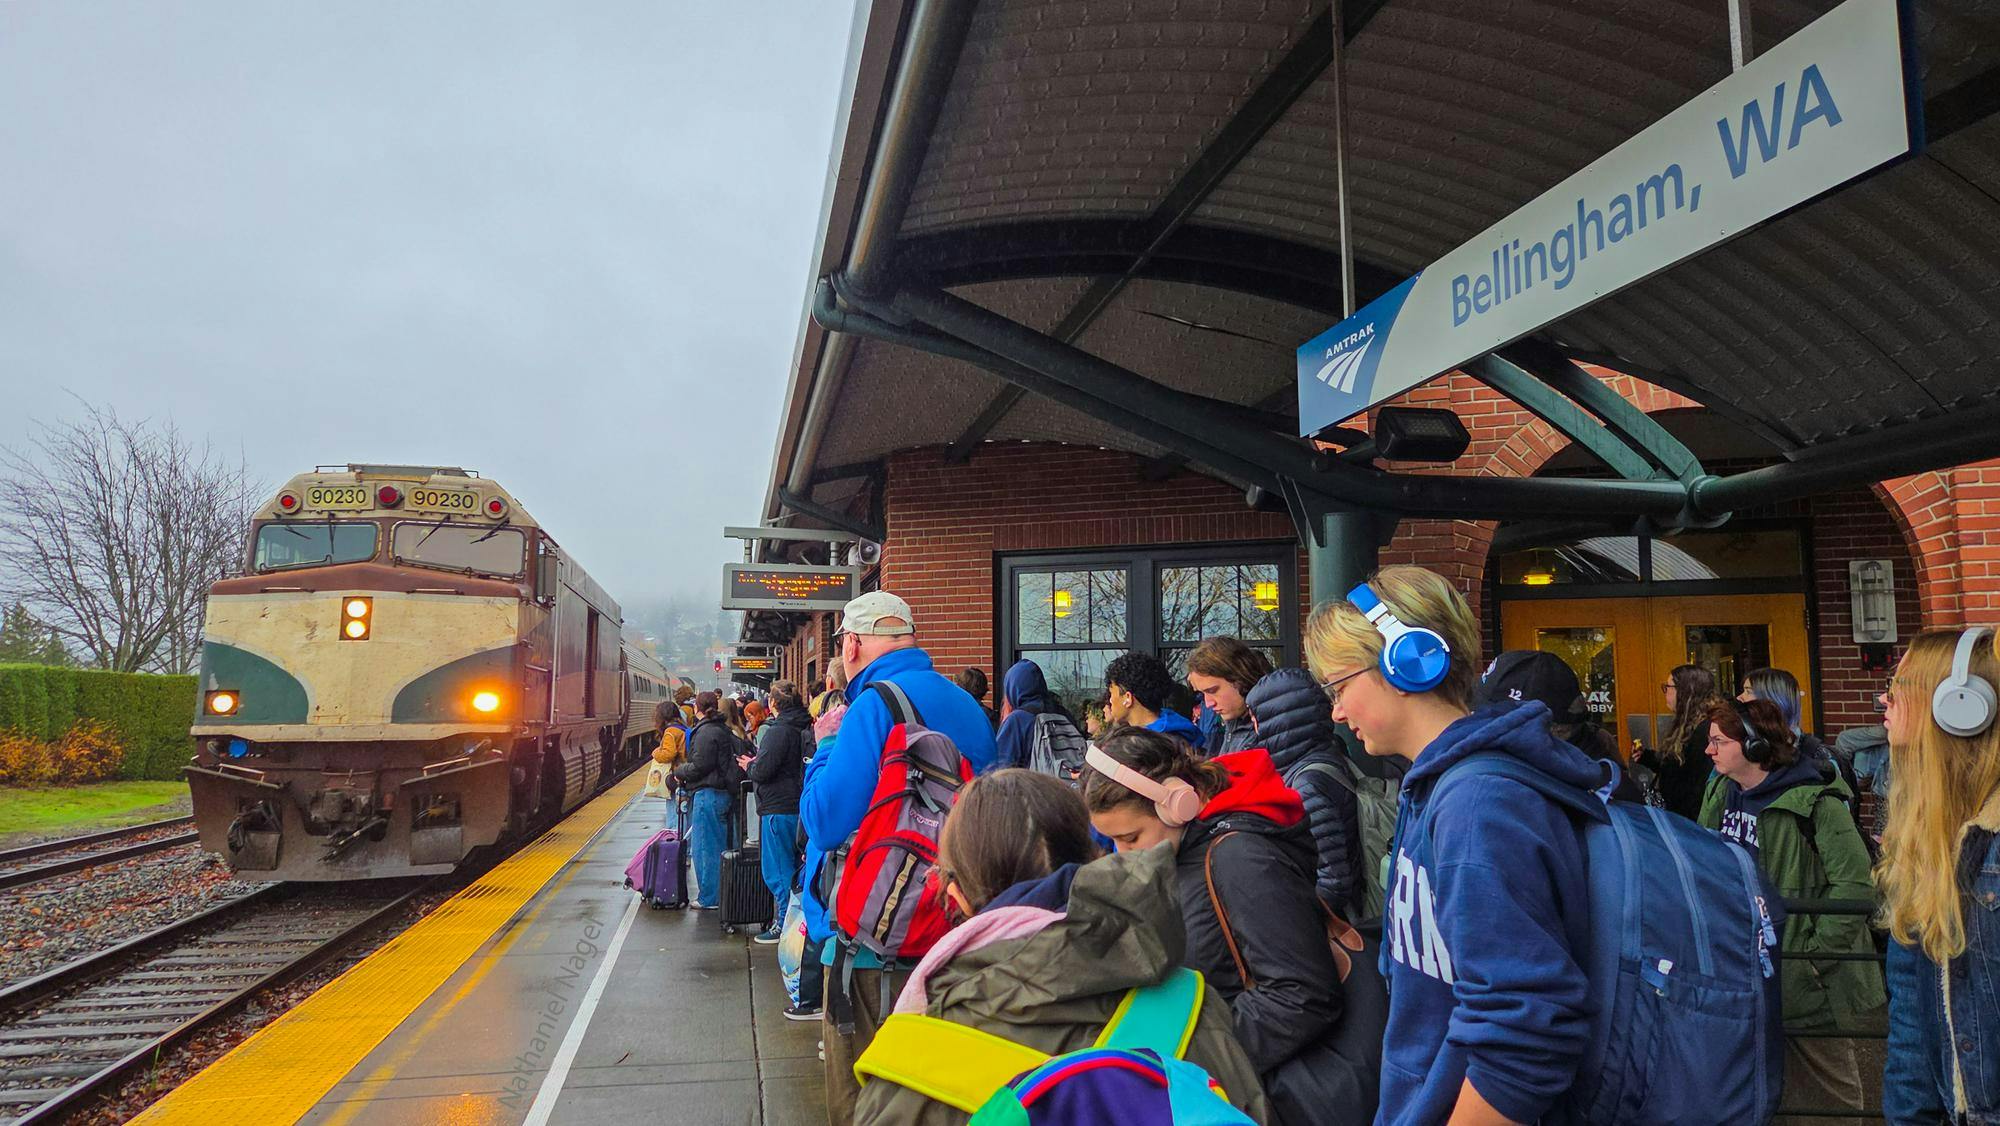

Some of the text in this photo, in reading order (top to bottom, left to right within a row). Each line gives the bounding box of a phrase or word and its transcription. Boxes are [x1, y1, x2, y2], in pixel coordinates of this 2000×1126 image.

[1452, 64, 1842, 328] Bellingham, WA
[1326, 322, 1374, 359] AMTRAK
[312, 489, 367, 504] 90230
[414, 490, 474, 509] 90230
[1508, 688, 1522, 701] 12
[1581, 691, 1612, 703] AK
[1388, 847, 1454, 985] RN
